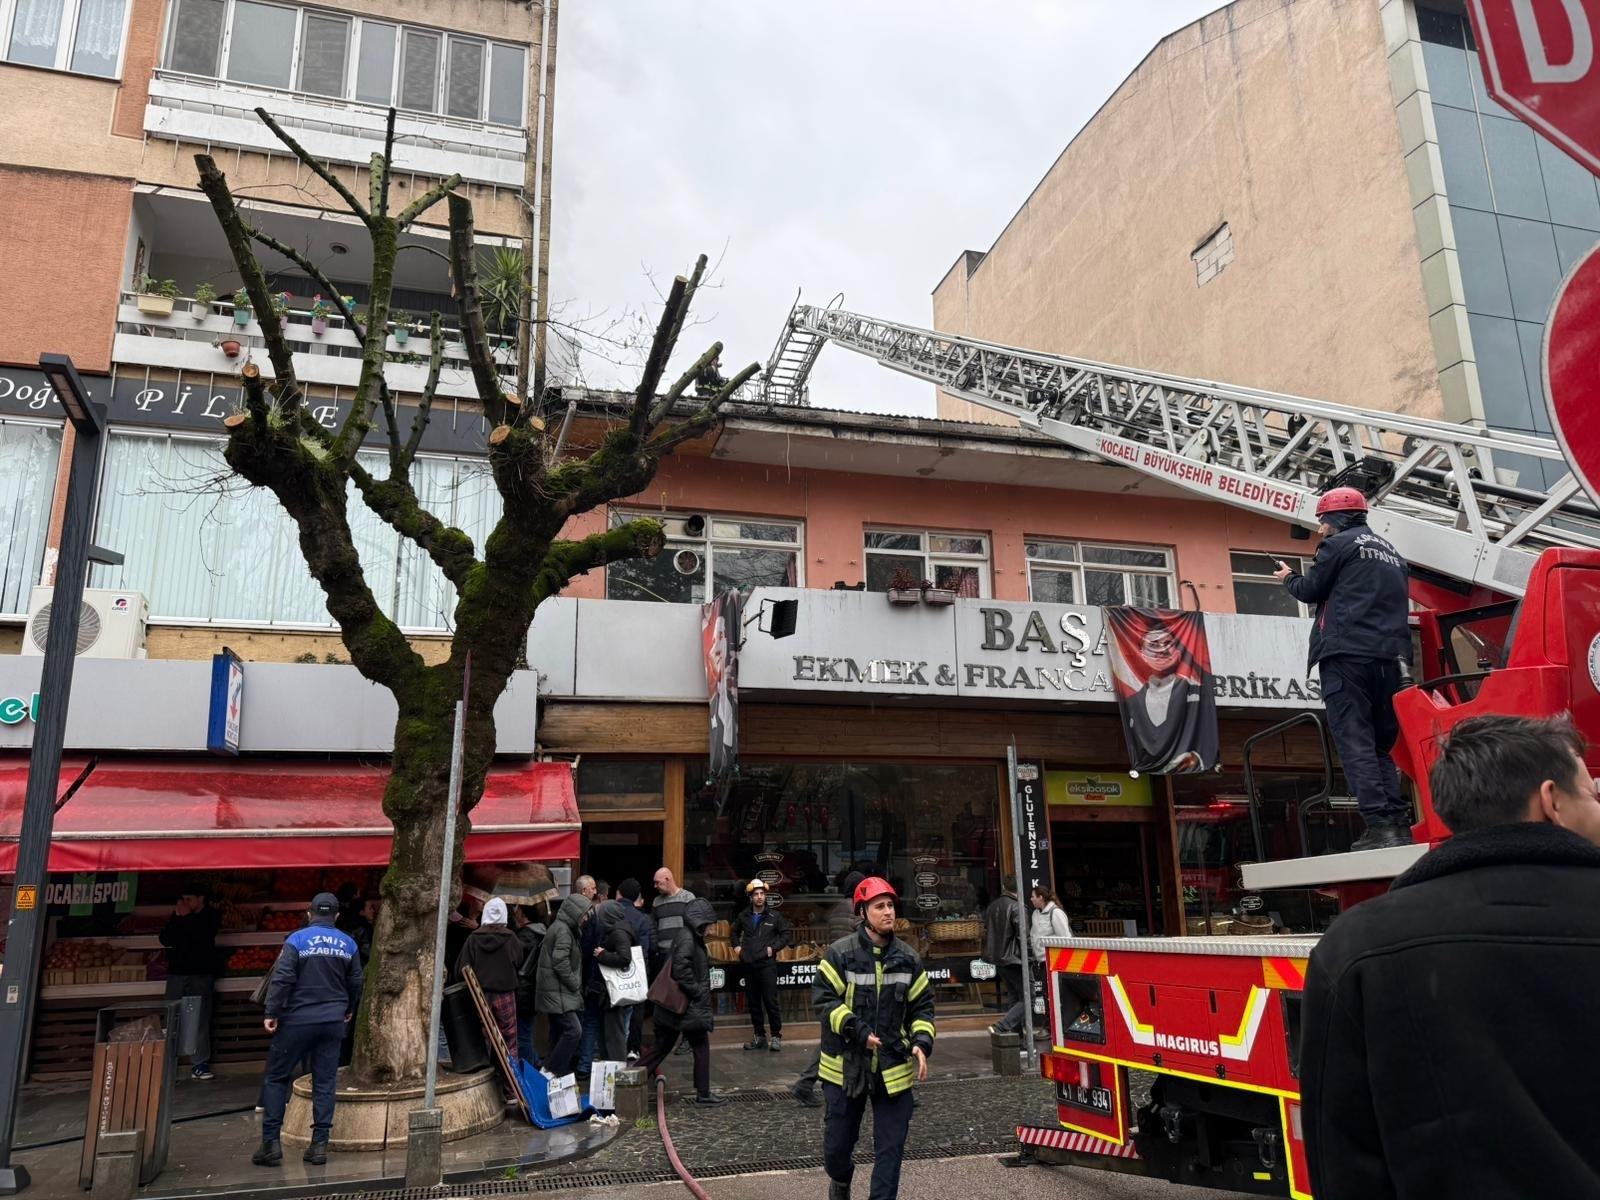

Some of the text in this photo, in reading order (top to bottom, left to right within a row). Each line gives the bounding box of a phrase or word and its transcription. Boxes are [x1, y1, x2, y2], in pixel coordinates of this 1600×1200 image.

[1100, 438, 1298, 513] KOCAELİ BÜYÜKŞEHİR BELEDİYESİ
[793, 655, 1323, 701] EKMEK & FRANCA BRİKAS
[45, 881, 129, 905] OCAELİSPOR
[791, 965, 817, 975] ŞEKE
[926, 968, 951, 979] MEĞİ
[1155, 1033, 1219, 1056] MAGIRUS
[1092, 1090, 1108, 1110] 934
